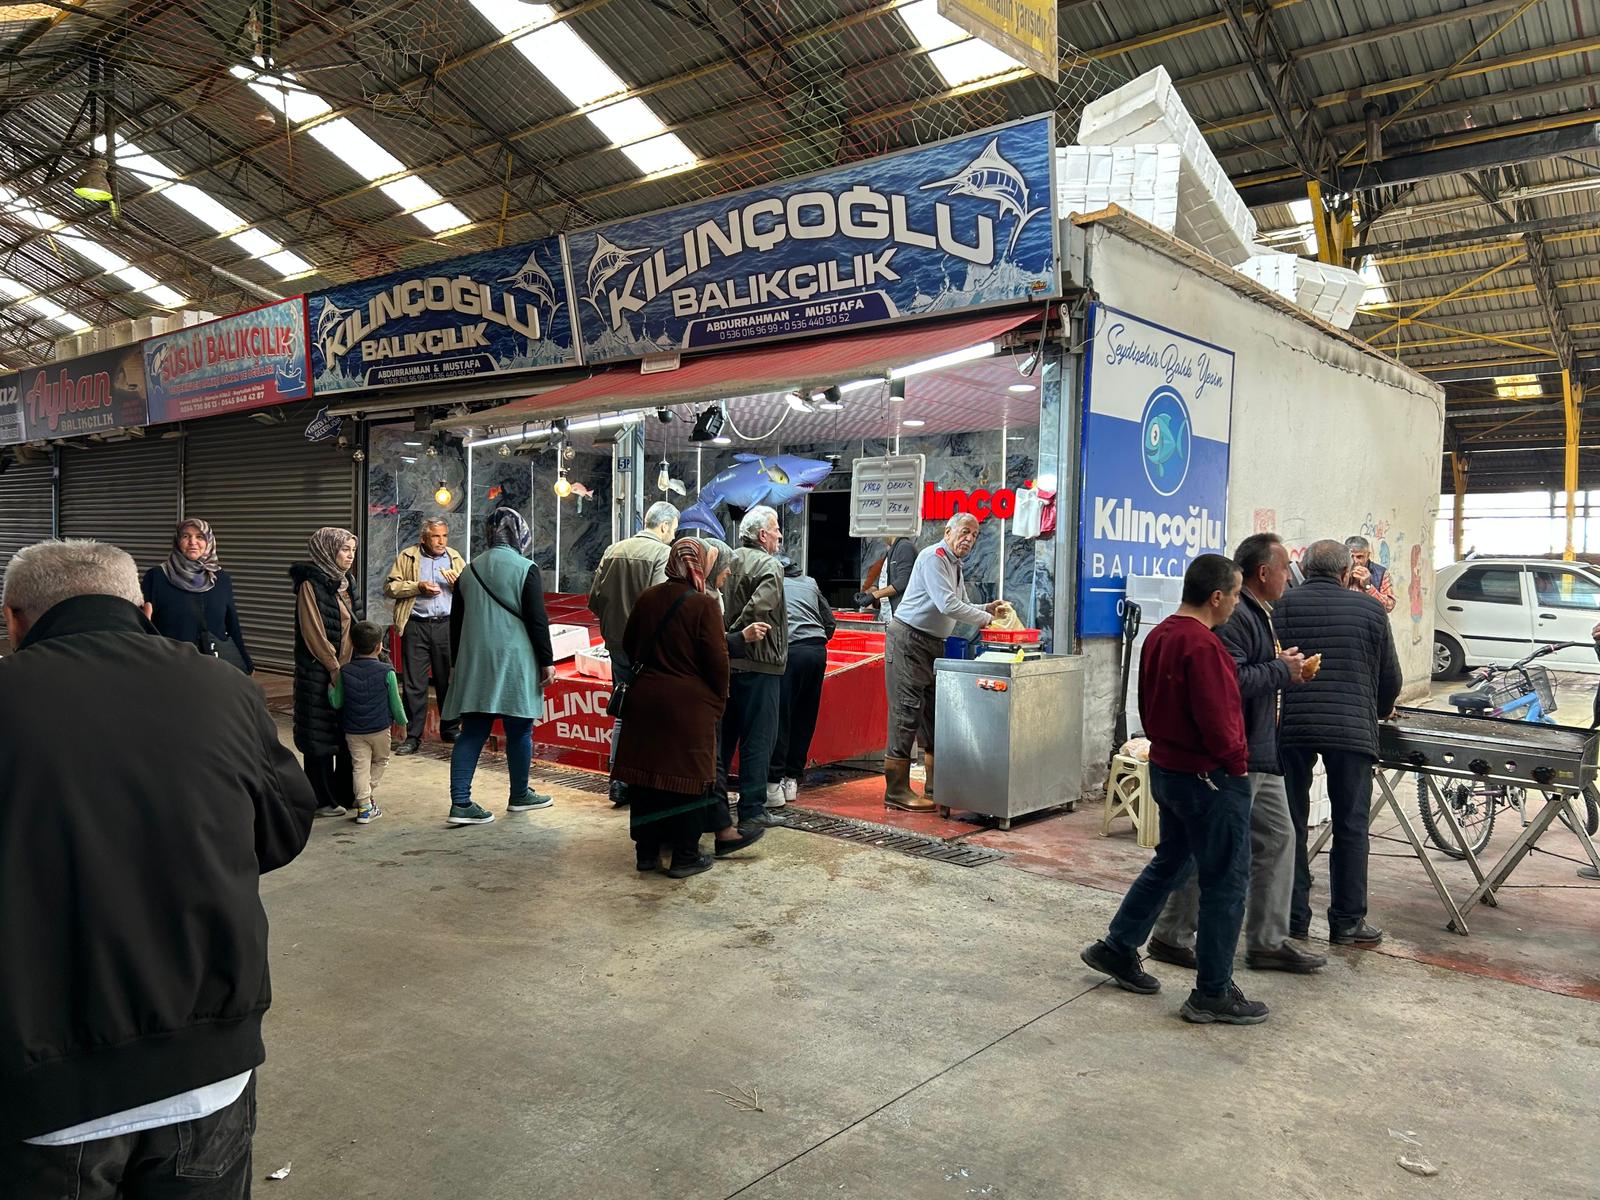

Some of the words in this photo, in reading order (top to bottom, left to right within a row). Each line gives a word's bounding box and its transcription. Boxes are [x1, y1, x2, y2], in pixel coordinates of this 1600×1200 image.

[609, 185, 995, 331] KILINÇOĞLU
[672, 247, 900, 318] BALIKÇILIK
[326, 275, 540, 371] KILINÇOĞLU
[361, 322, 491, 362] BALIKÇILIK
[706, 311, 790, 333] ABDURRAHMAN
[805, 299, 864, 318] MUSTAFA
[719, 332, 725, 340] 0
[726, 329, 741, 339] 536
[742, 327, 755, 337] 016
[755, 325, 766, 335] 96
[767, 324, 778, 334] 99
[784, 322, 790, 331] 0
[791, 319, 807, 329] 536
[809, 317, 825, 327] 440
[826, 315, 837, 325] 90
[839, 312, 850, 323] 52
[25, 368, 112, 431] Ayhan
[378, 365, 430, 379] ABDURRAHMAN
[443, 359, 480, 371] MUSTAFA
[1094, 497, 1221, 558] Kılınçoğlu
